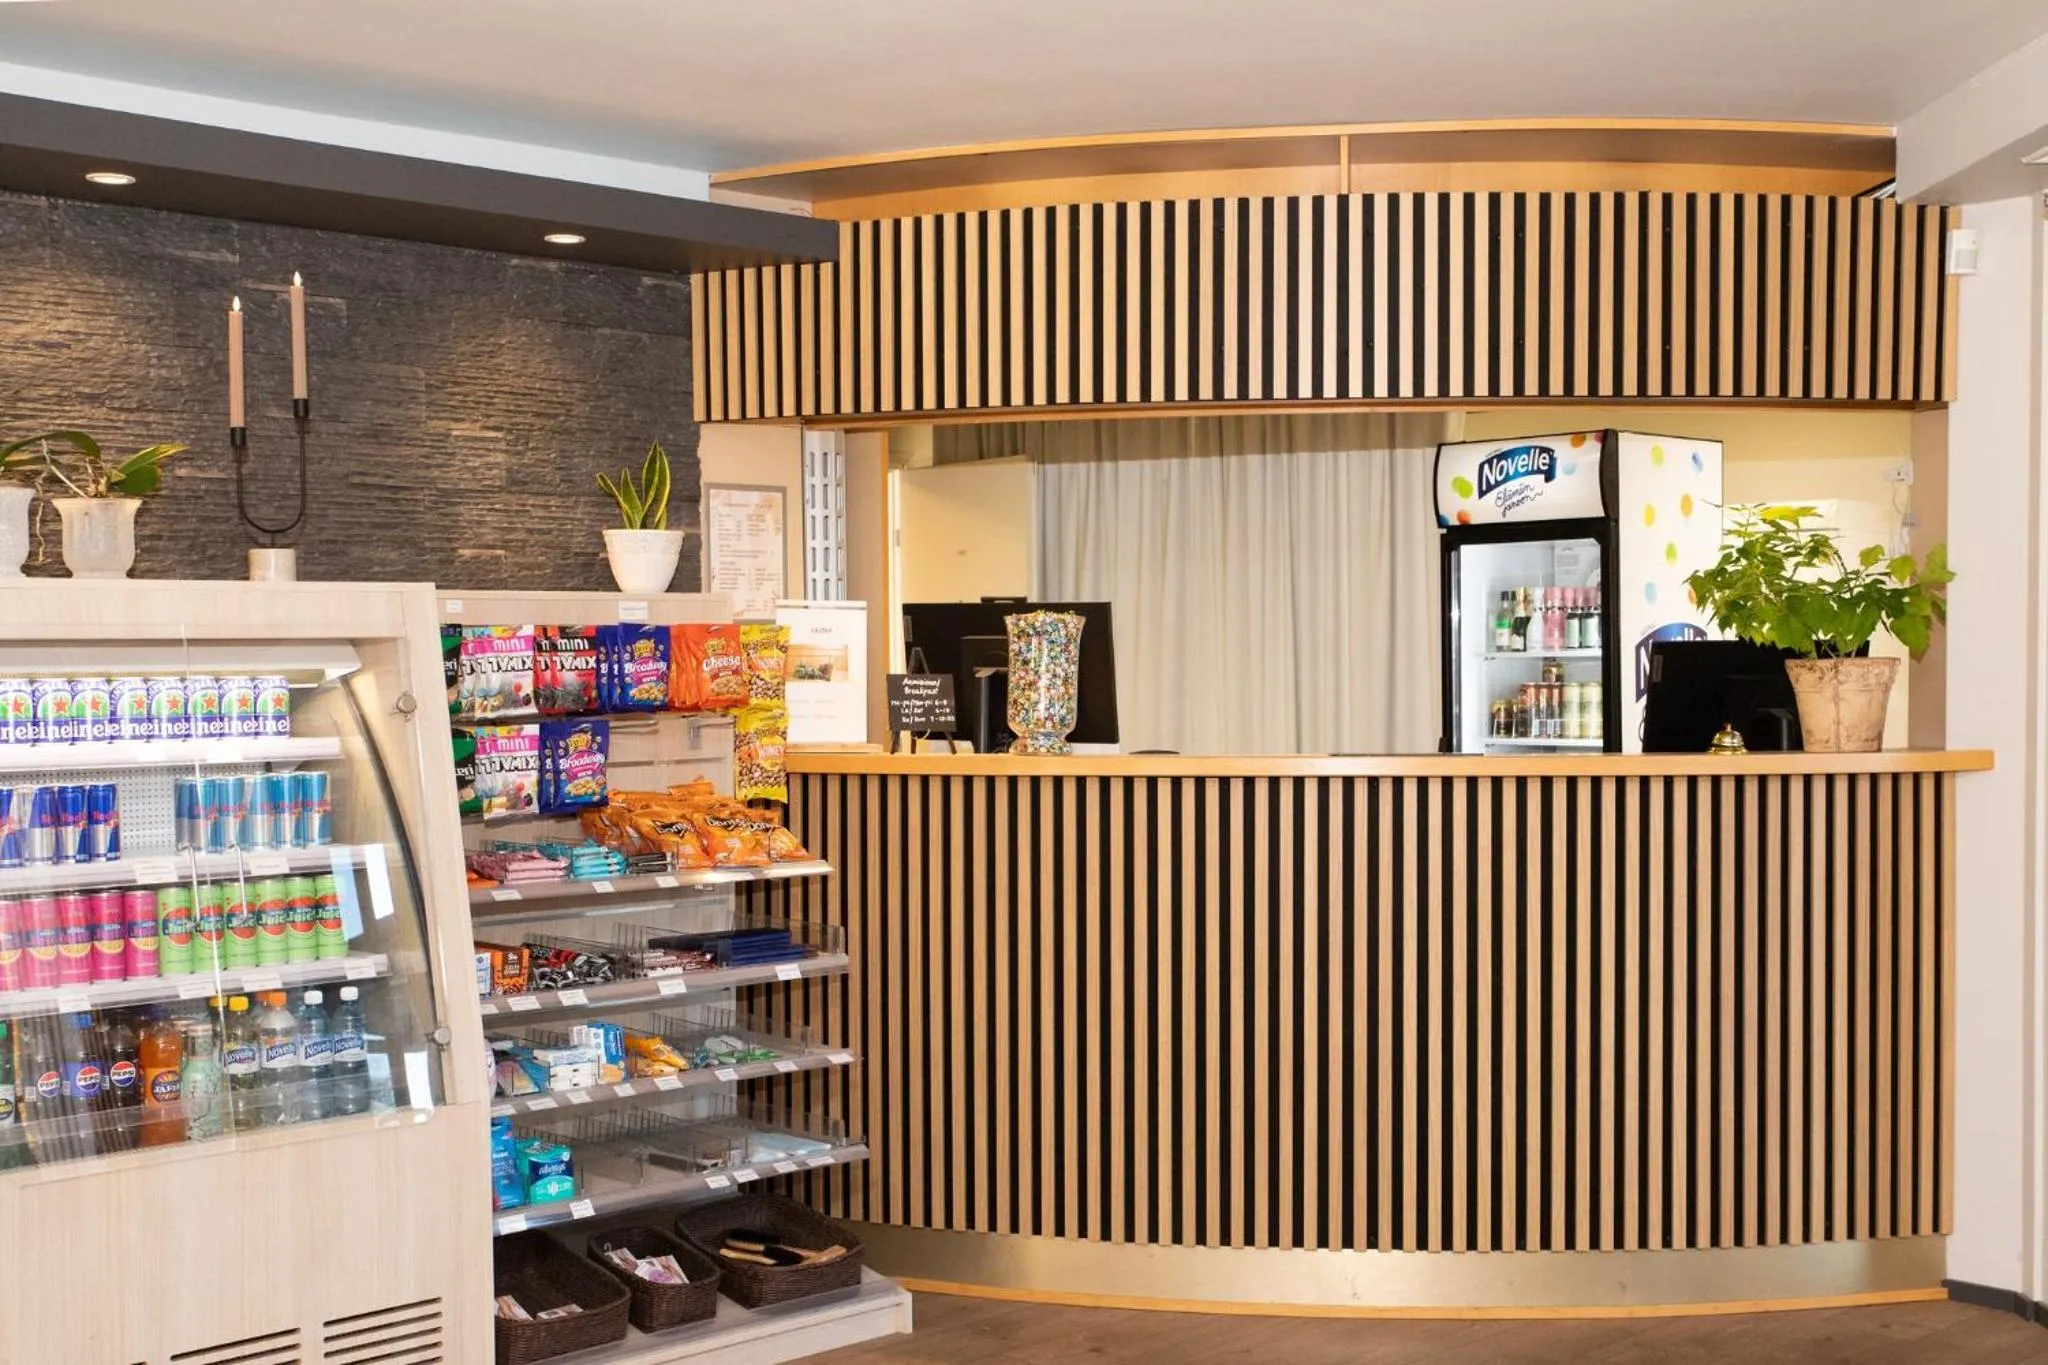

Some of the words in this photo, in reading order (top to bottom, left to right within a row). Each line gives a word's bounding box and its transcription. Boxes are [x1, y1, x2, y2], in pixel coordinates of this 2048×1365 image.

[1482, 448, 1550, 492] Novelle
[493, 638, 526, 650] mini
[557, 637, 588, 650] mini
[702, 655, 741, 671] Cheese
[497, 738, 529, 752] mini
